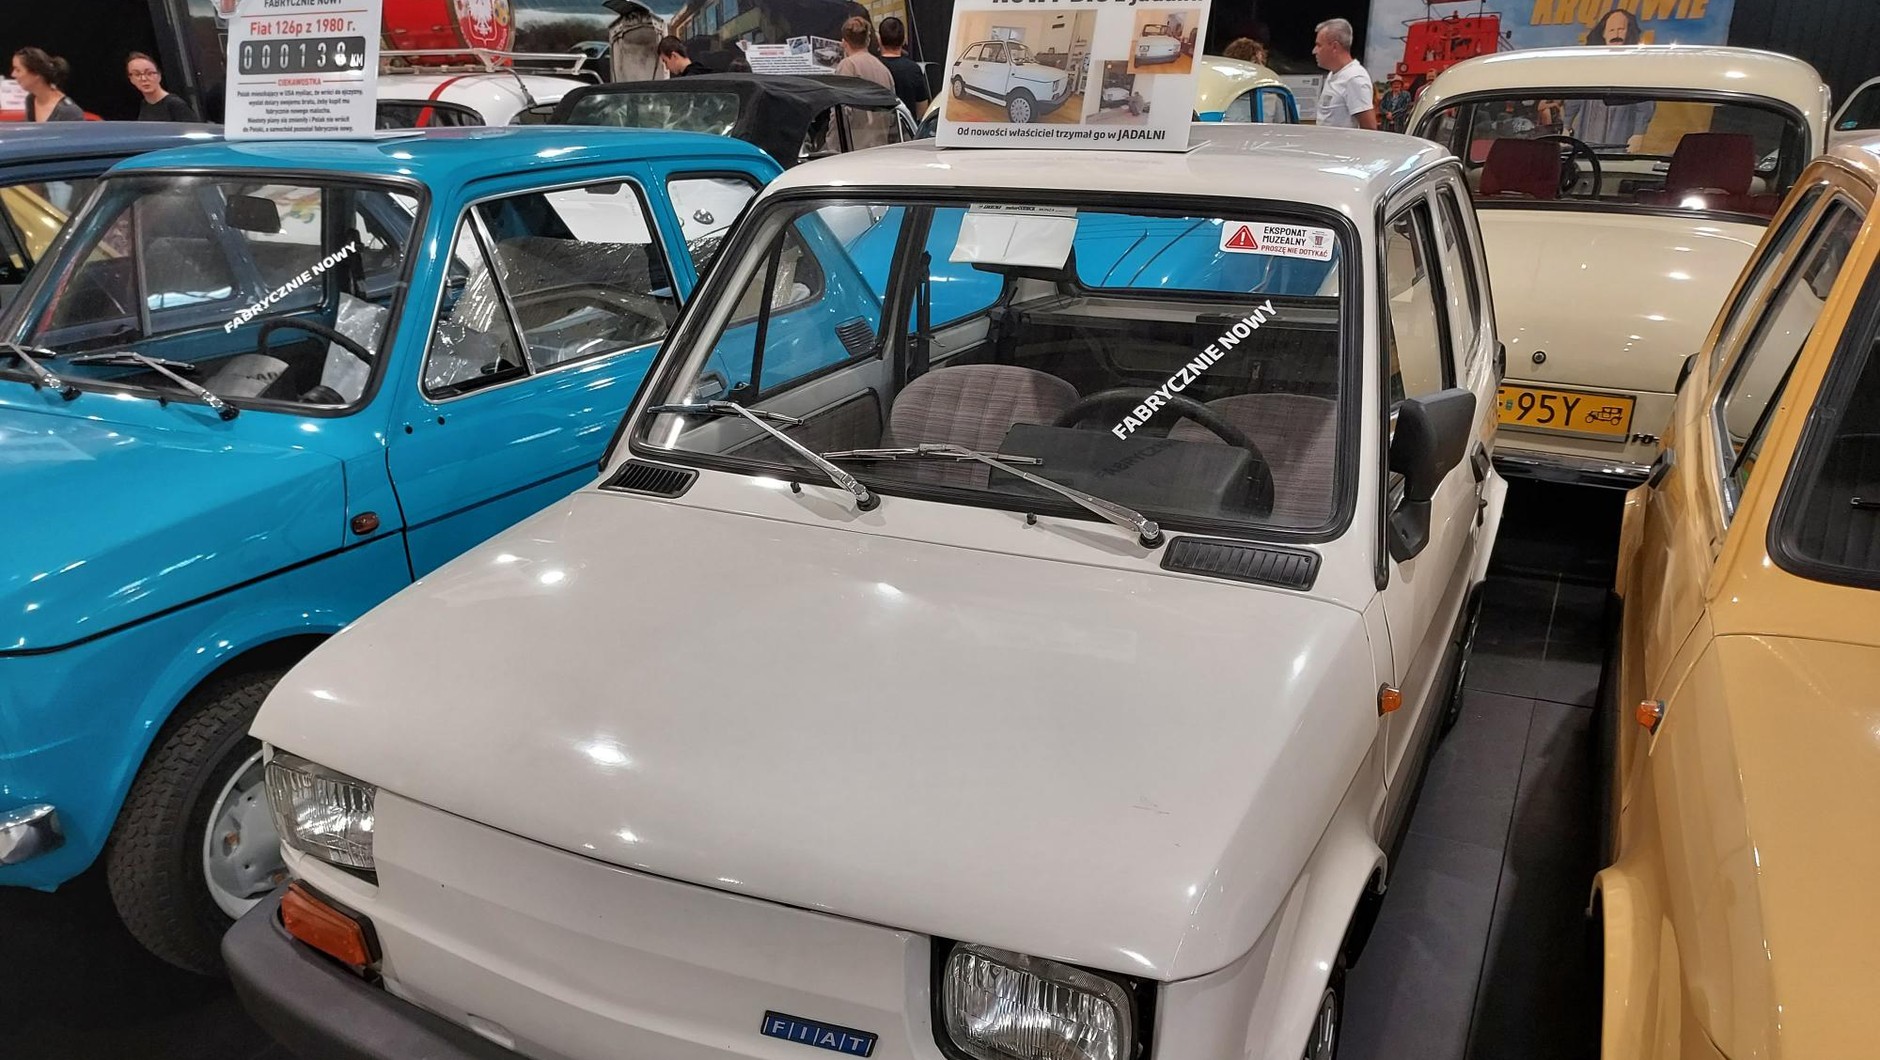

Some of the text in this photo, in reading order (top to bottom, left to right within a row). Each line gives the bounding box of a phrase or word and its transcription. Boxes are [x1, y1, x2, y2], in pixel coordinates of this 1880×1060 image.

[250, 18, 356, 37] Fiat 126p z 1980 r.
[277, 78, 321, 87] CIEKAWOSTKA
[957, 127, 970, 136] Od
[971, 128, 1008, 136] nowości
[1009, 128, 1055, 137] właściciel
[1056, 129, 1092, 140] trzymał
[1093, 131, 1106, 141] go
[1117, 129, 1166, 141] JADALNI
[1263, 226, 1307, 237] EKSPONAT
[1262, 235, 1307, 247] MUZEALNY
[1261, 245, 1328, 258] PROSZĘ NIE DOTYKAĆ
[223, 241, 358, 334] FABRYCZNIE NOWY
[1111, 299, 1277, 441] FABRYCZNIE NOWY
[771, 1020, 865, 1051] FIAT
